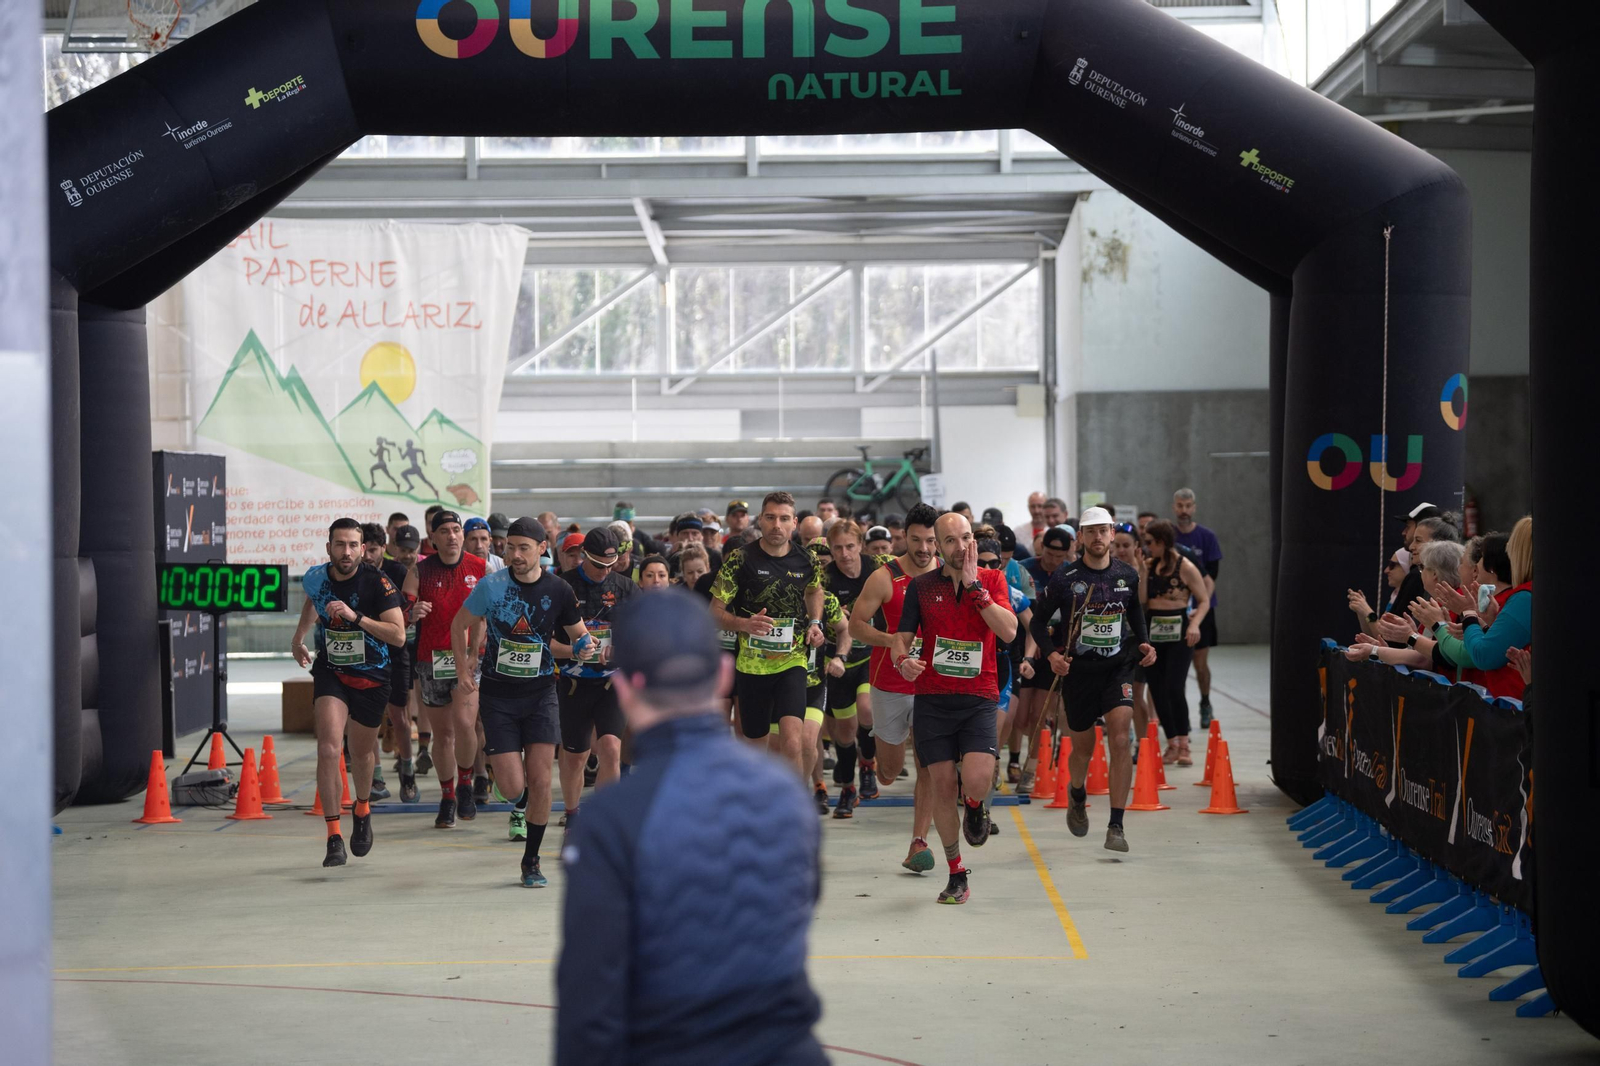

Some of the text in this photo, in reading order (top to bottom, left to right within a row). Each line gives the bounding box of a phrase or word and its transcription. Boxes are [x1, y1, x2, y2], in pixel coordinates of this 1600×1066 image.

[1084, 80, 1128, 109] OURENSE
[1088, 69, 1148, 107] DEPUTACIÓN
[177, 120, 208, 140] inorde
[184, 121, 233, 150] turismo Ourense
[1176, 117, 1205, 138] inorde
[1171, 129, 1217, 157] turismo Ourense
[79, 149, 145, 187] DEPUTACIÓN
[86, 168, 134, 197] OURENSE
[226, 222, 288, 250] AIL
[243, 257, 397, 288] PADERNE
[299, 295, 483, 330] de ALLARIZ
[1307, 432, 1424, 492] OU
[241, 501, 254, 511] se
[257, 498, 305, 512] percibe
[308, 500, 315, 509] a
[318, 497, 375, 509] sensación
[277, 514, 301, 526] que
[268, 527, 299, 540] pode
[161, 567, 280, 608] 10:00:02
[722, 629, 735, 638] 30
[1093, 624, 1113, 633] 305
[333, 641, 353, 651] 273
[909, 647, 922, 656] 24
[947, 650, 970, 661] 255
[443, 656, 456, 665] 22
[509, 652, 531, 663] 282
